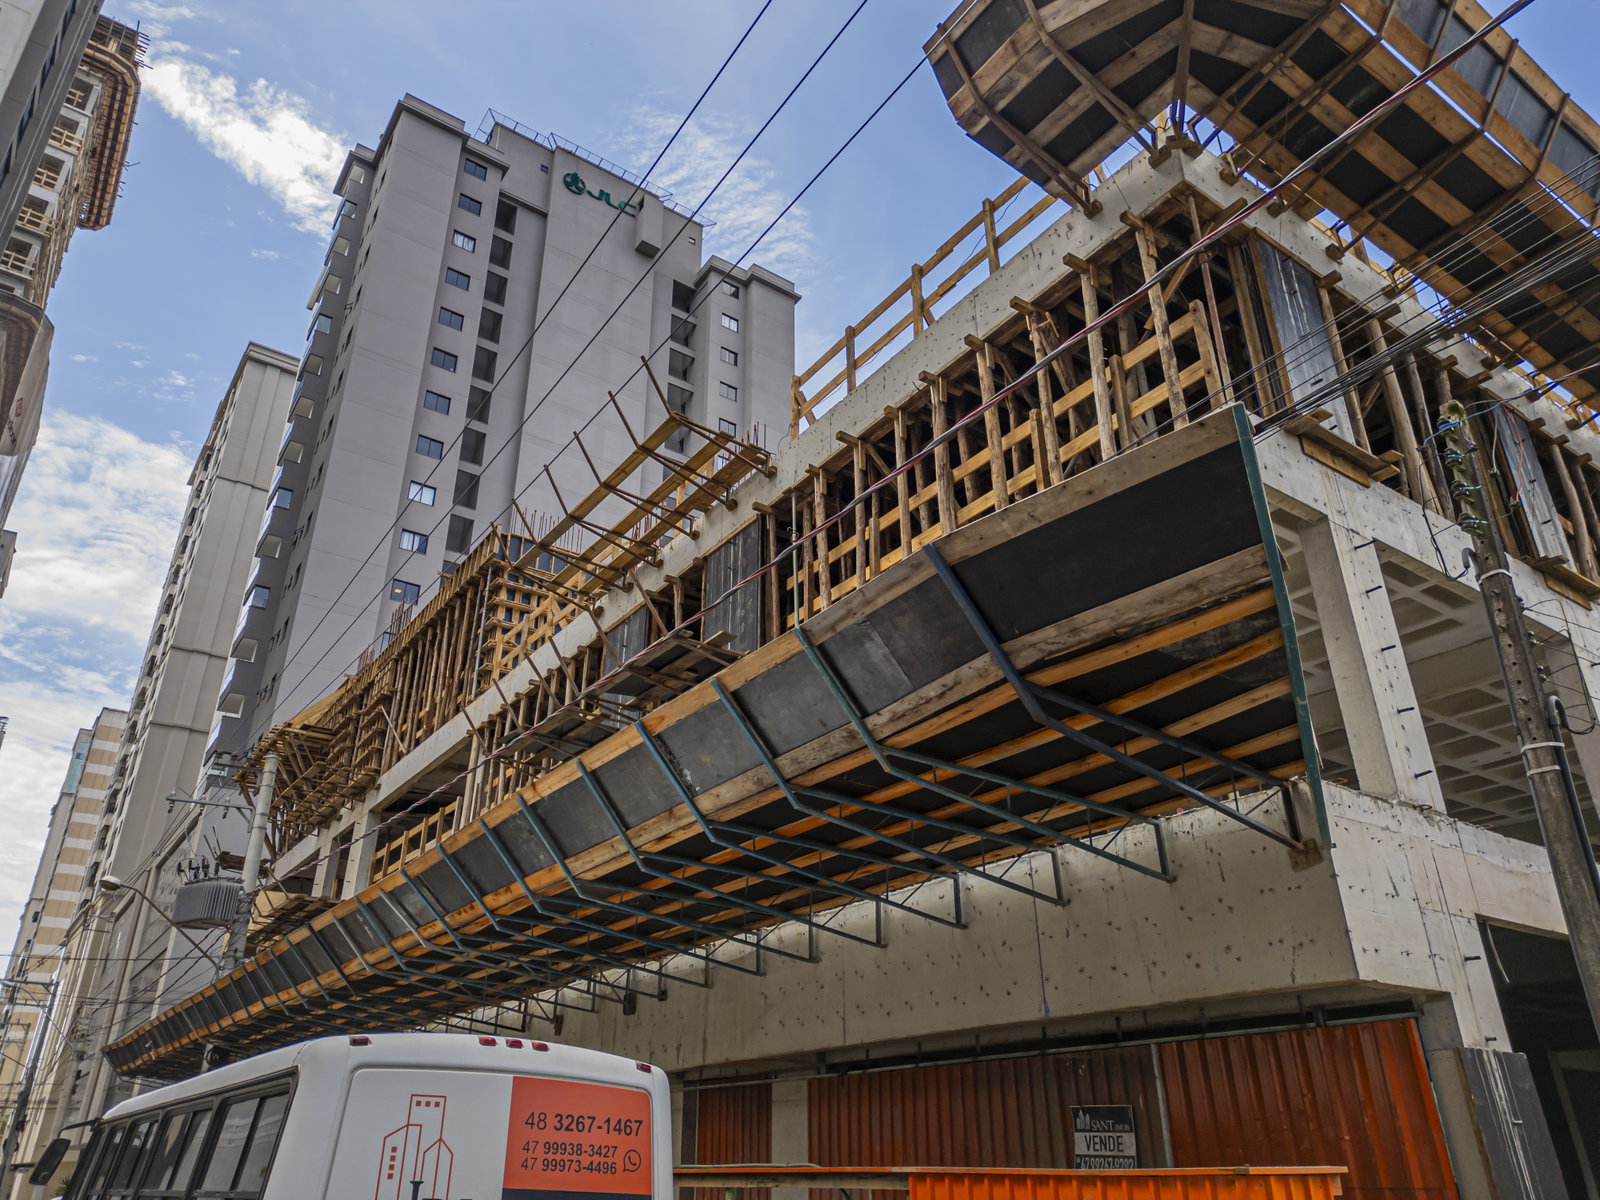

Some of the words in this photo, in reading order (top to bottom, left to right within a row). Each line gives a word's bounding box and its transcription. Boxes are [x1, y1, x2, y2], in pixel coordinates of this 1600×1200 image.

[524, 1112, 547, 1131] 48
[553, 1113, 643, 1137] 3267-1467
[1090, 1119, 1114, 1131] SANT
[522, 1140, 539, 1154] 47
[543, 1141, 618, 1159] 99938-3427
[1084, 1135, 1124, 1153] VENDE
[520, 1157, 538, 1171] 47
[541, 1158, 617, 1175] 99973-4496
